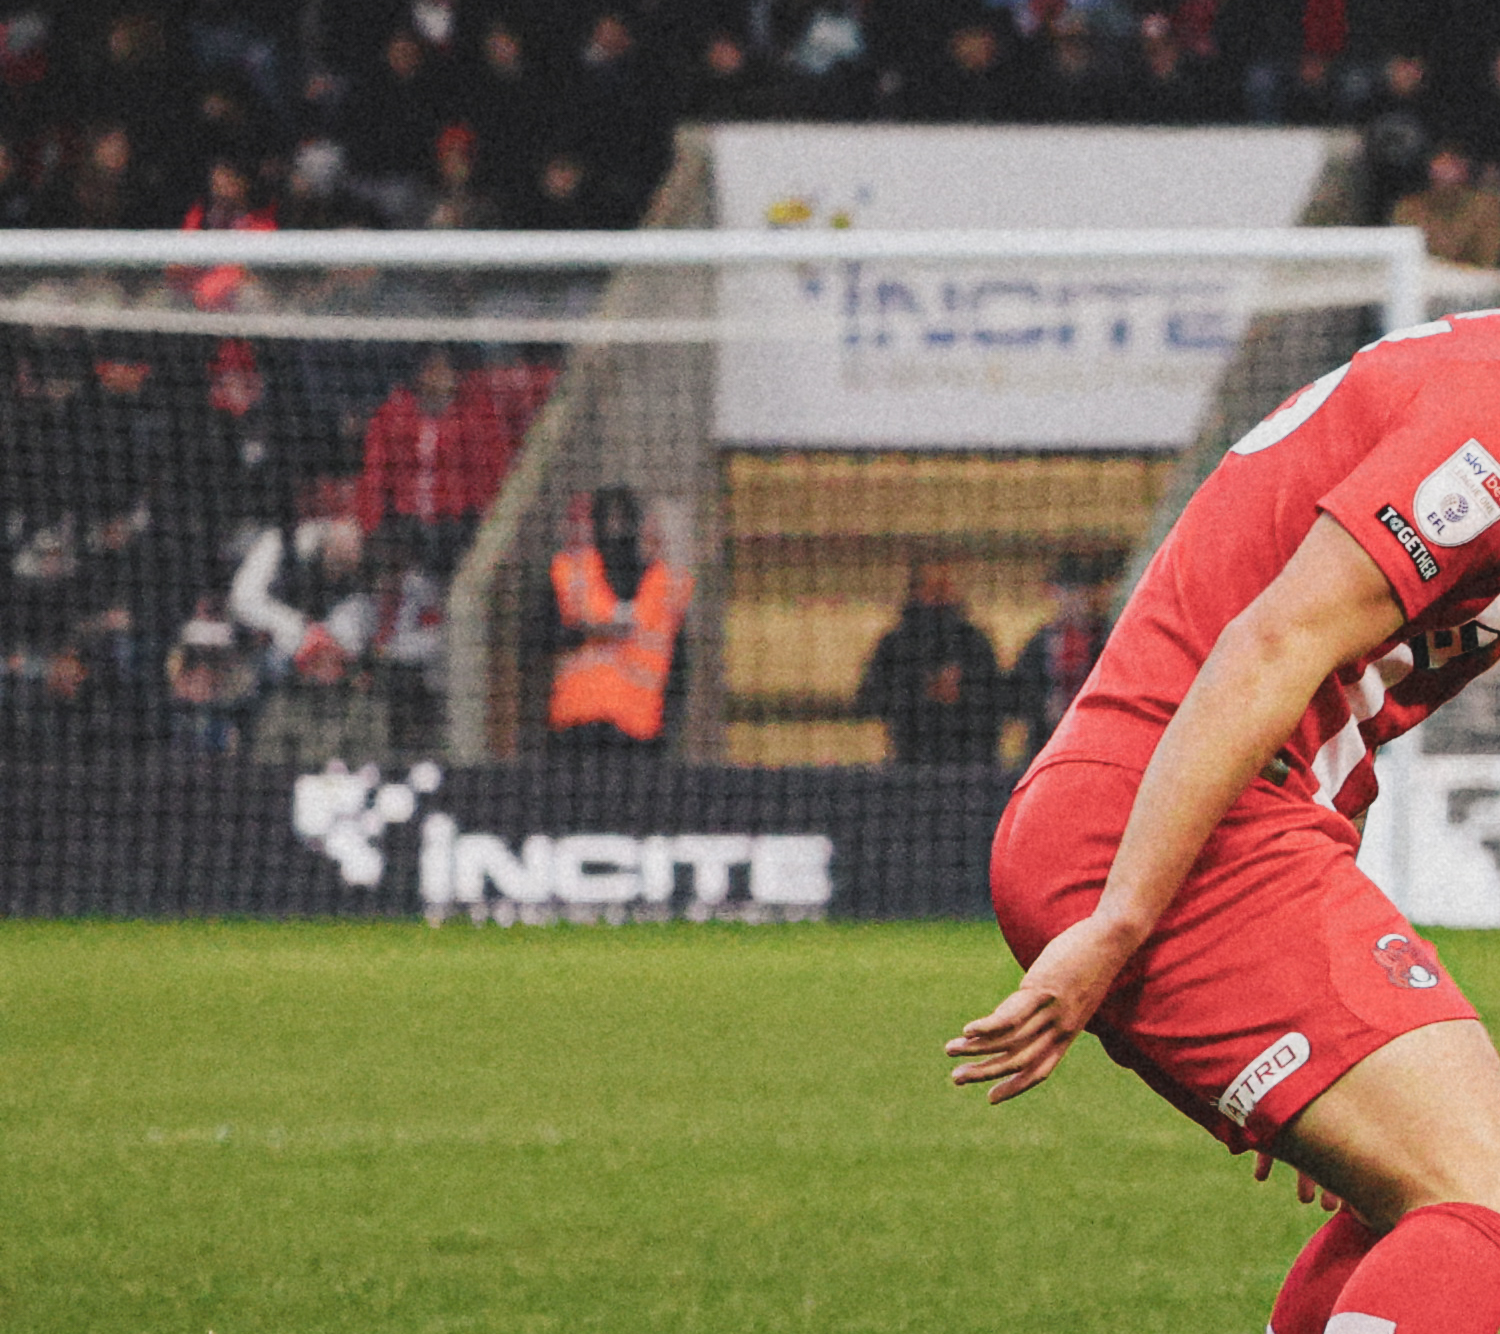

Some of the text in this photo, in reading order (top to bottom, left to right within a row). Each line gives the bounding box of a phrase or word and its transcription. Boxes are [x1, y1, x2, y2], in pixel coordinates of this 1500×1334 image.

[1463, 452, 1487, 476] sky
[1427, 511, 1447, 536] EFL
[1381, 506, 1438, 580] TOGETHER
